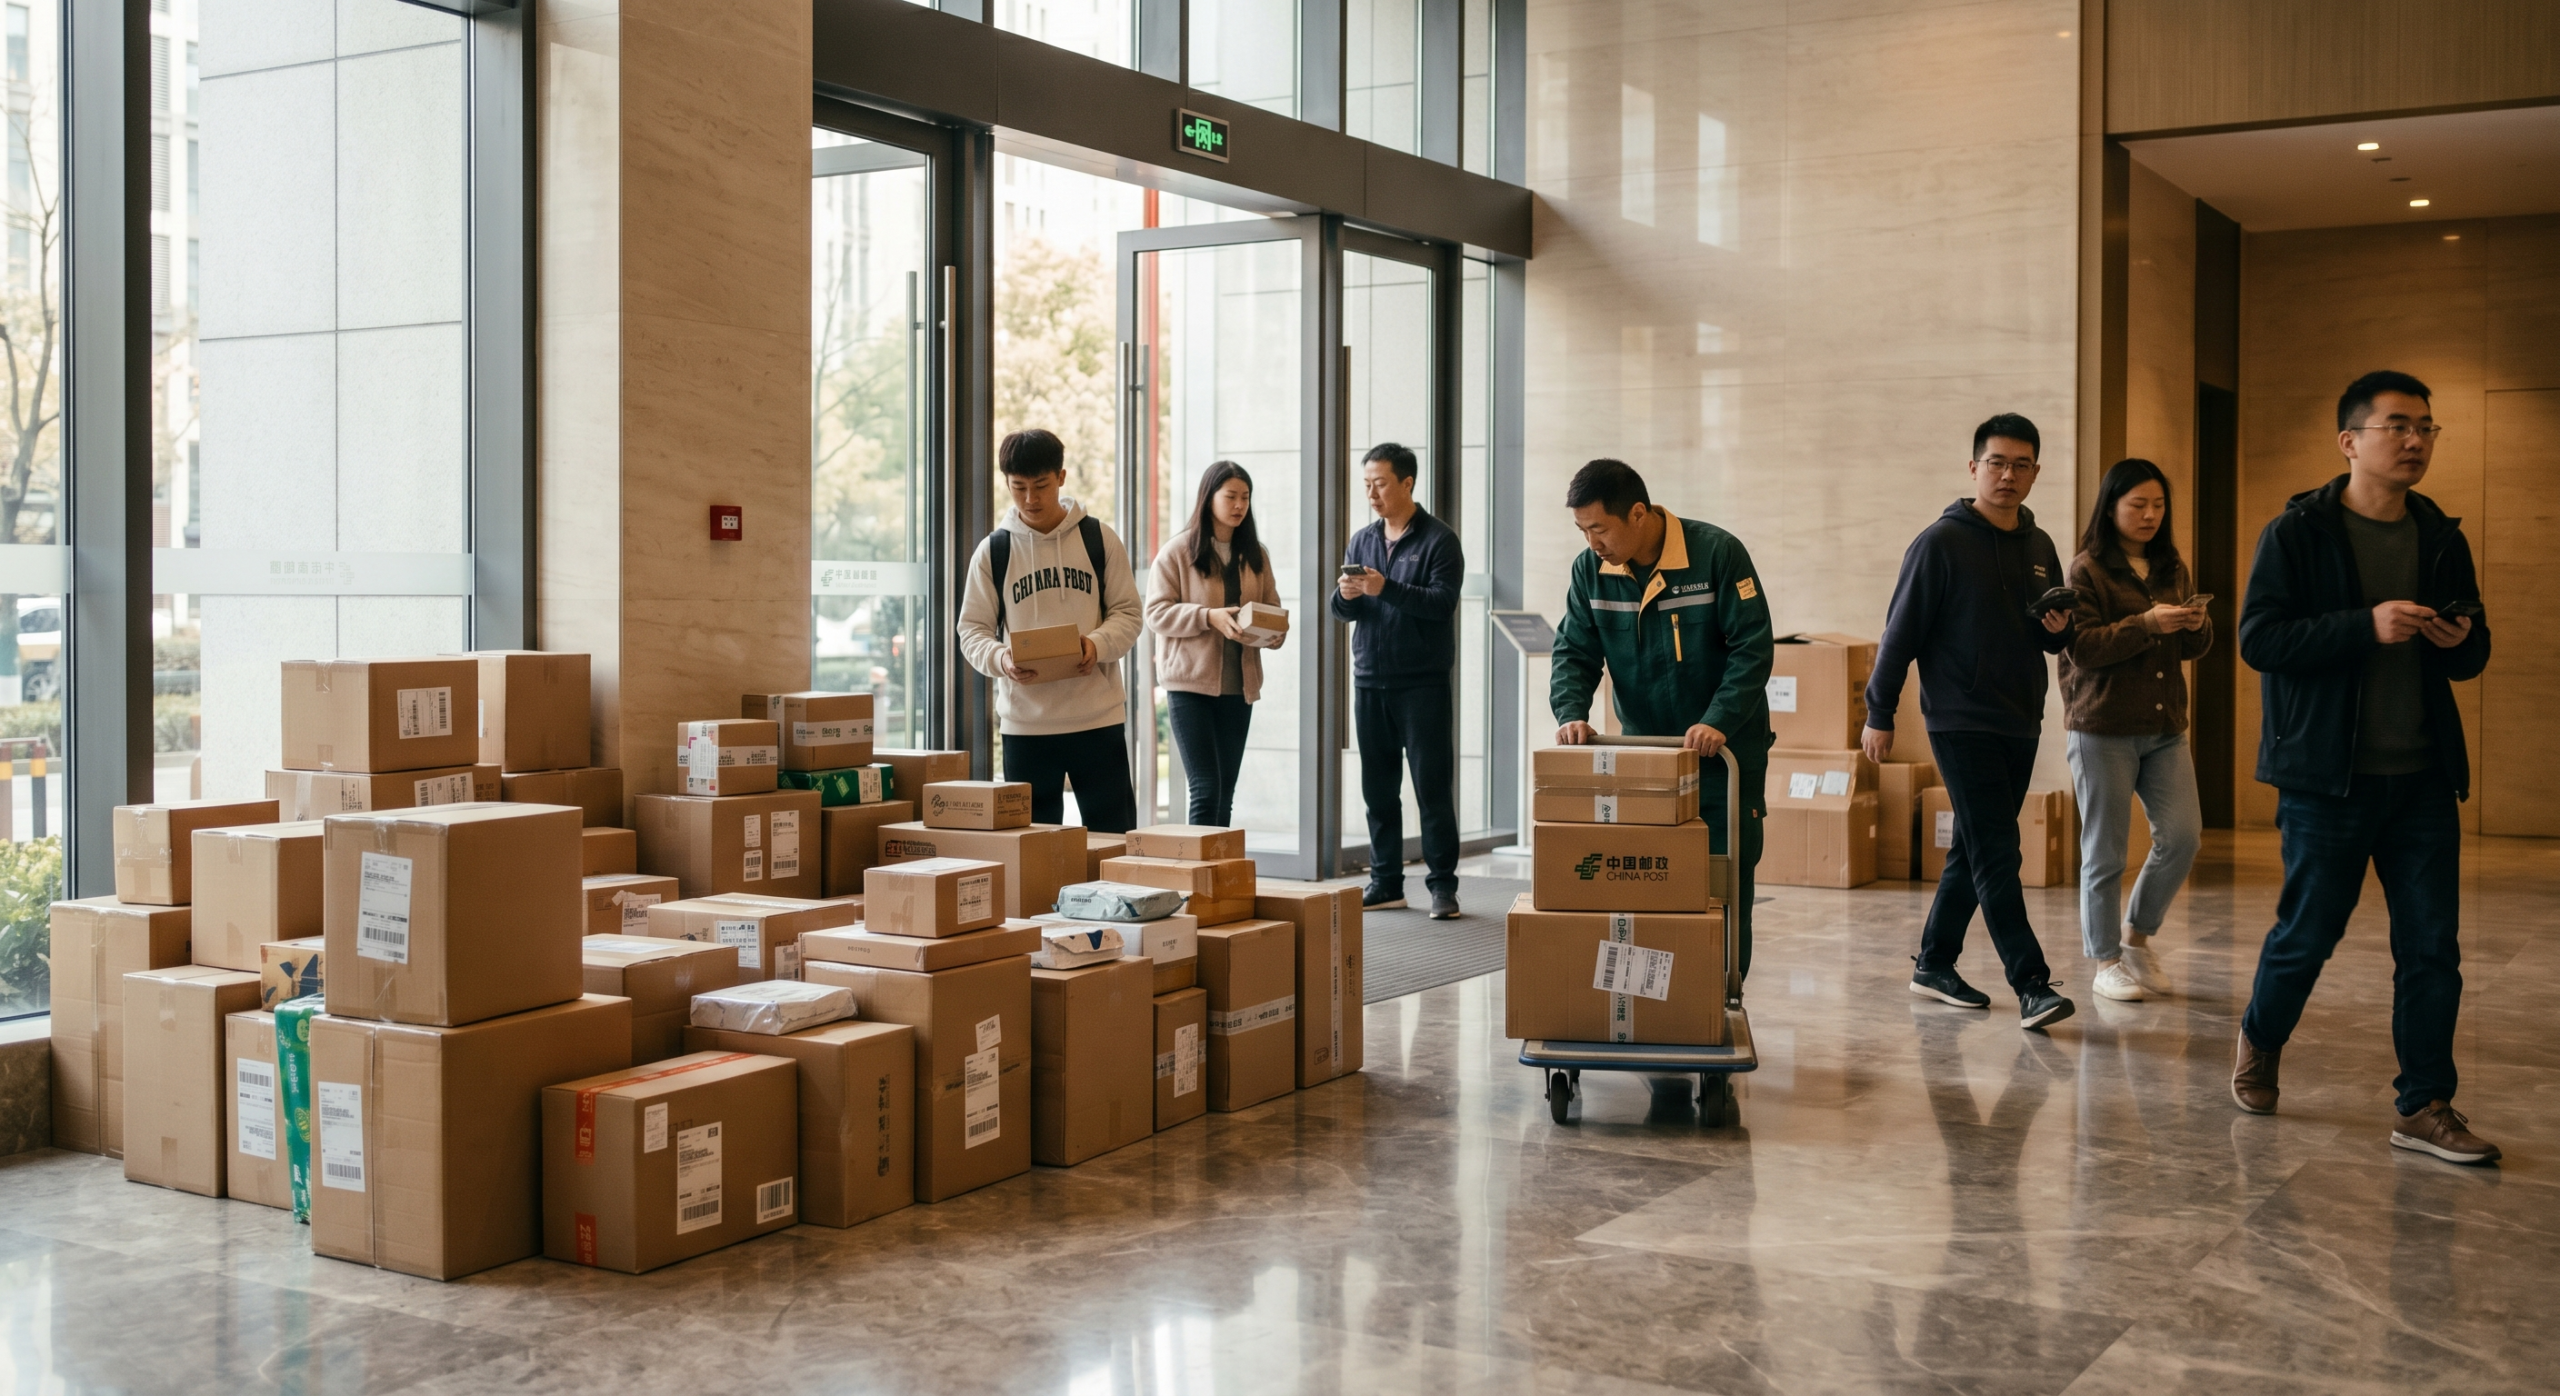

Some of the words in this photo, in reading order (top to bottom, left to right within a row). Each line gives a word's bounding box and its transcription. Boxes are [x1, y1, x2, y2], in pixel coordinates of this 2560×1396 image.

[1606, 855, 1669, 870] 中国邮政
[1606, 871, 1641, 881] CHINA
[1643, 871, 1669, 882] POST
